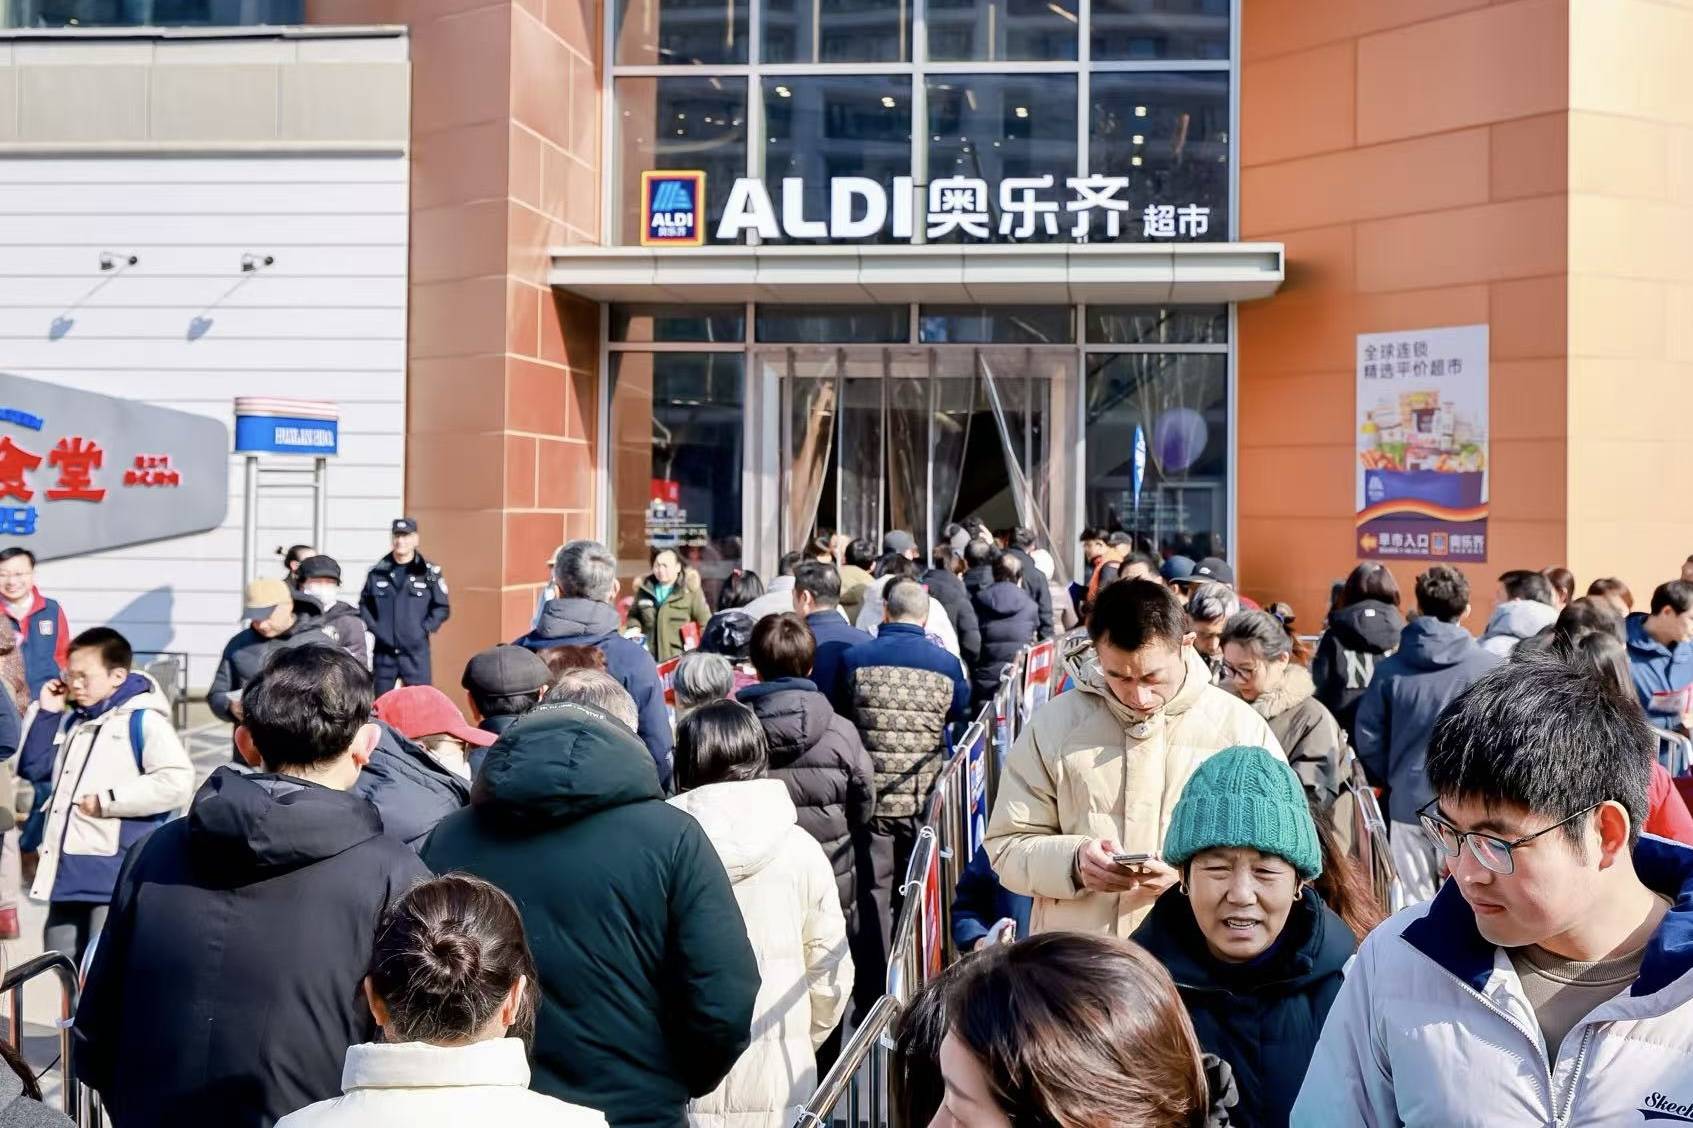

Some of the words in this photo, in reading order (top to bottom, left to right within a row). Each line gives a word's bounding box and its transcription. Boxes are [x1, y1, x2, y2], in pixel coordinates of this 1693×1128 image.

[716, 176, 913, 239] ALDI
[927, 174, 1130, 239] 奥乐齐
[1142, 203, 1211, 238] 超市
[651, 212, 694, 227] ALDI
[1364, 341, 1429, 361] 全球连锁
[1364, 358, 1463, 379] 精选平价超市
